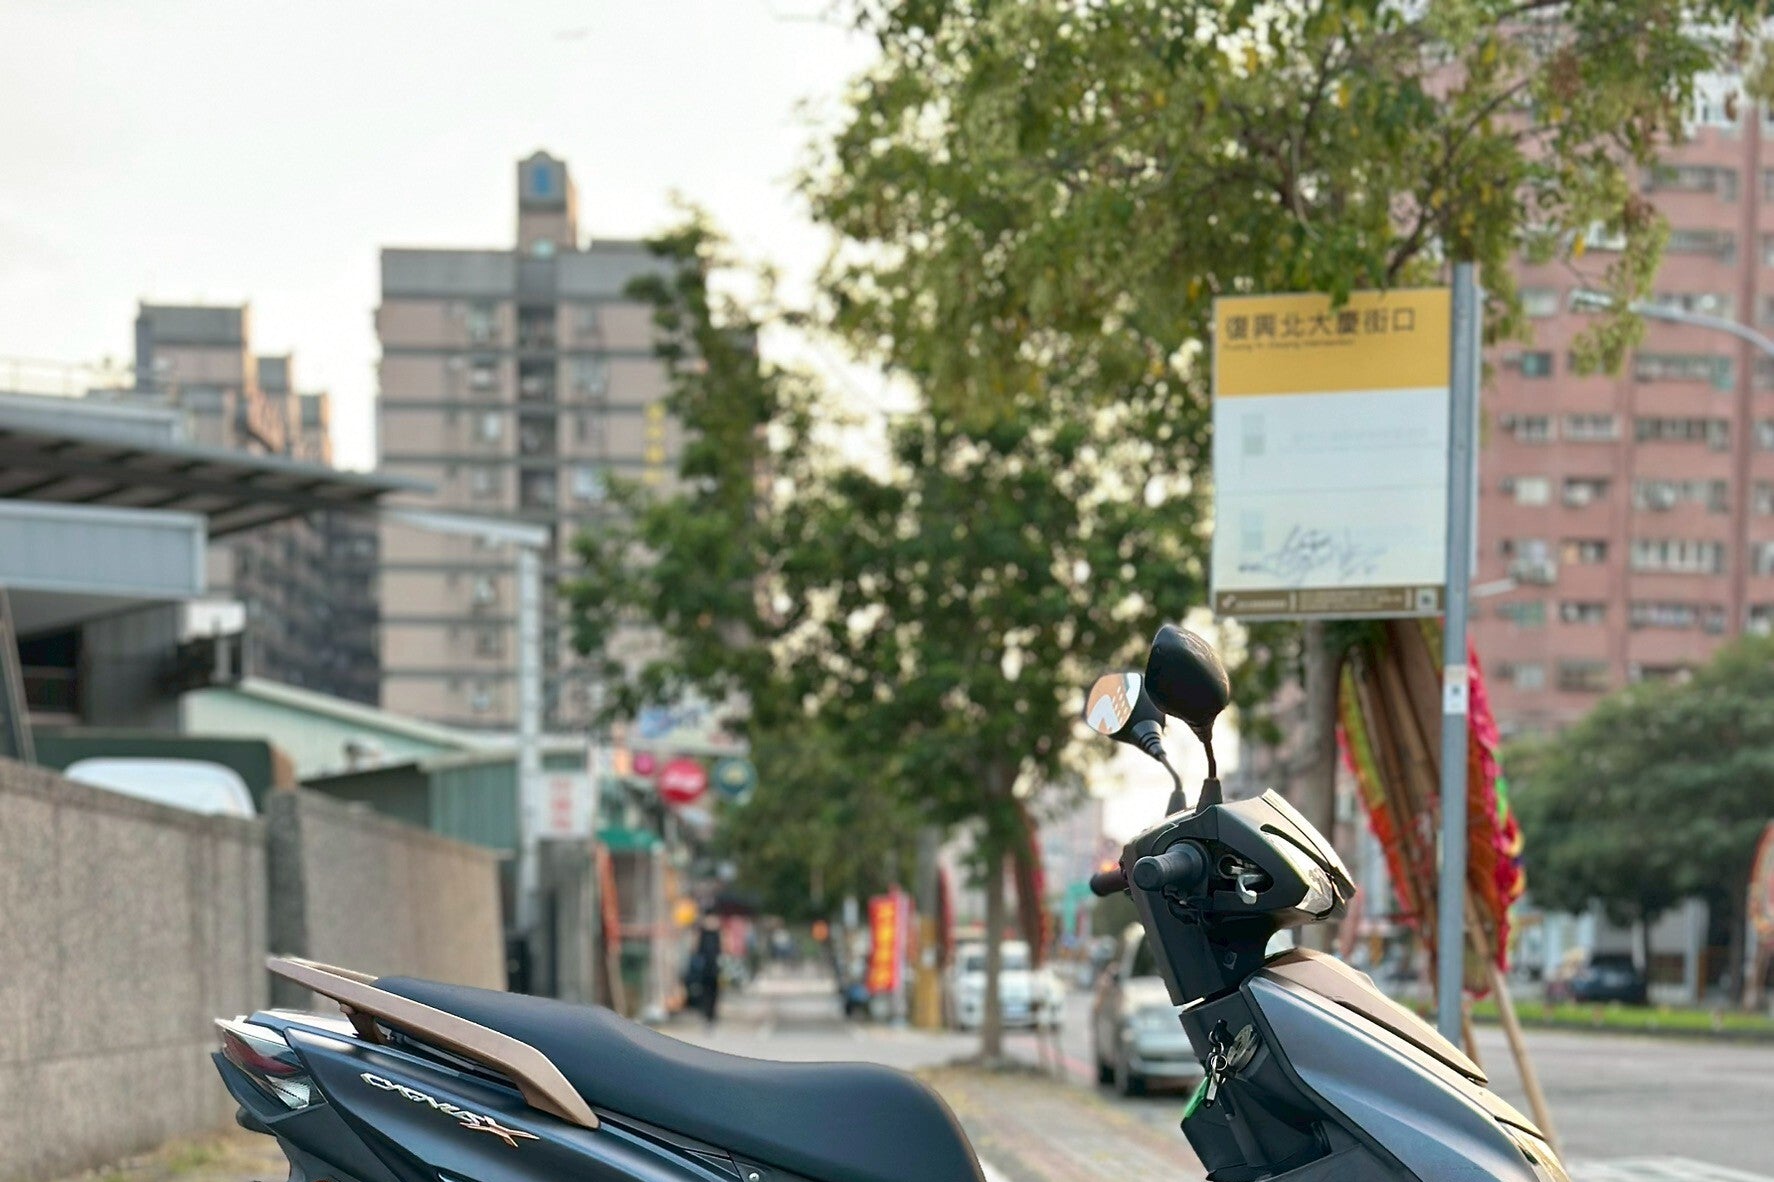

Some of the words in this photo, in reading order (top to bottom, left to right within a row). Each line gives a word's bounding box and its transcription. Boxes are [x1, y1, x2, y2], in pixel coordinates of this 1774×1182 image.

[1225, 307, 1415, 340] 復興北大慶街口
